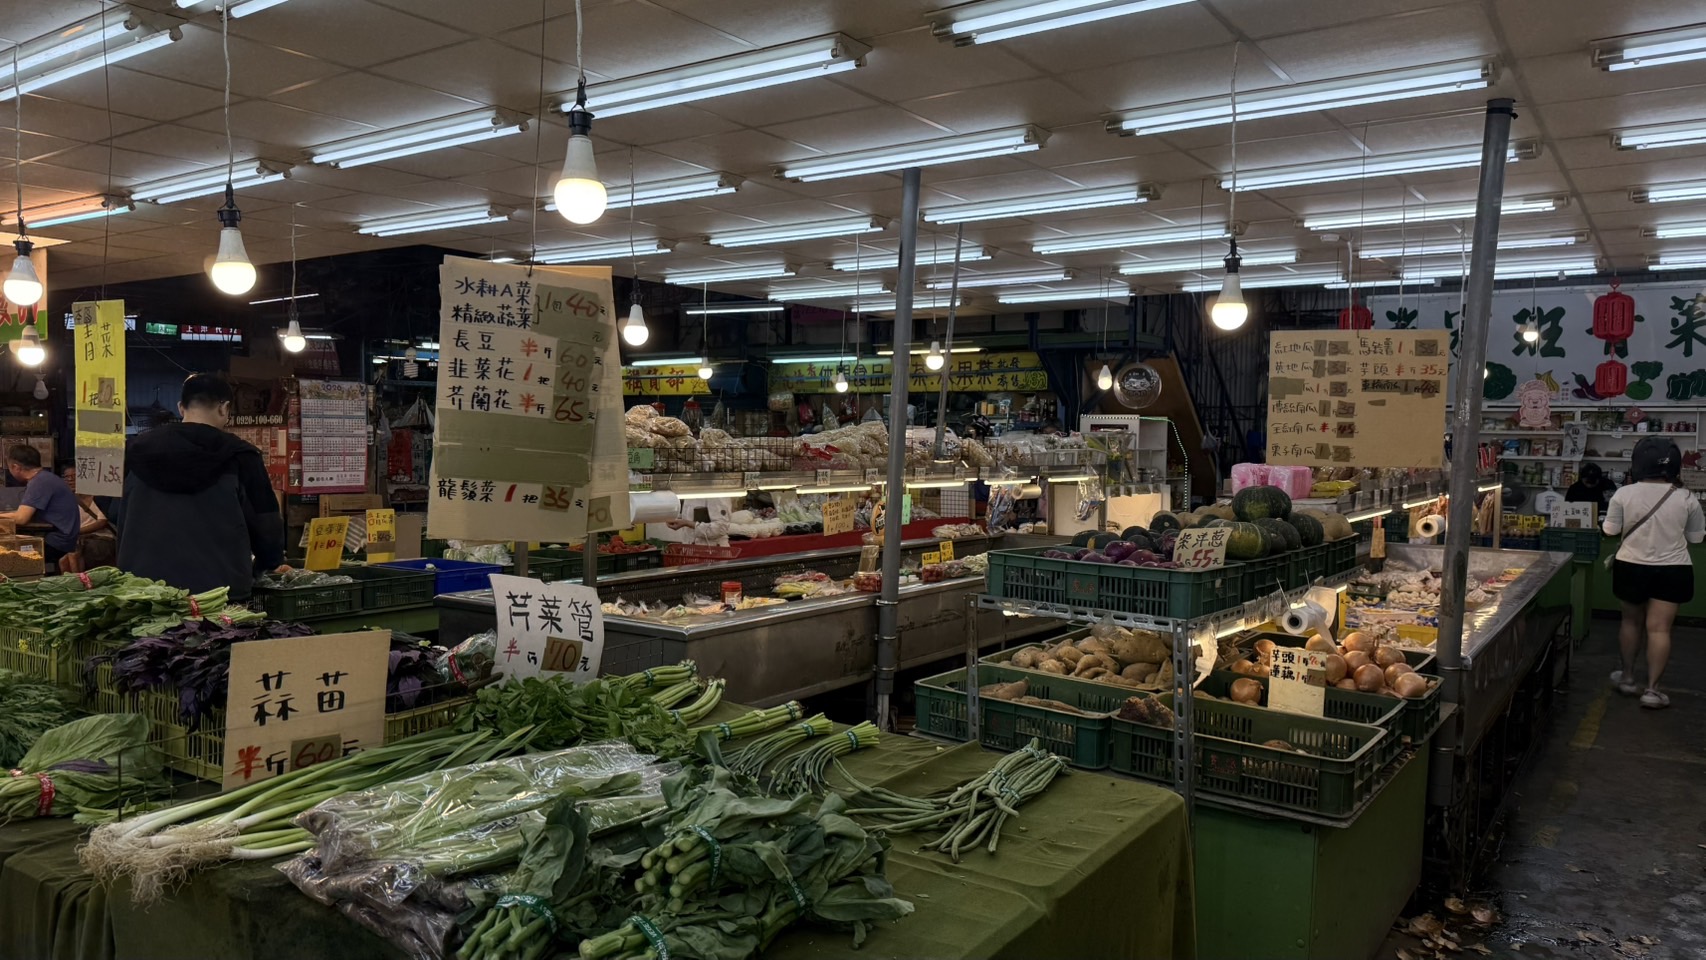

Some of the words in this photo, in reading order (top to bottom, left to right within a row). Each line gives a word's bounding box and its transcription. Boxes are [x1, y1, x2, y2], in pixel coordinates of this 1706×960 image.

[455, 276, 532, 306] 水耕A菜
[451, 303, 533, 329] 精緻蔬菜
[453, 329, 496, 351] 長豆
[1360, 362, 1389, 376] 芋頭
[446, 385, 513, 411] 芥蘭花
[505, 590, 595, 642] 芹菜管
[250, 670, 350, 727] 蒜苗
